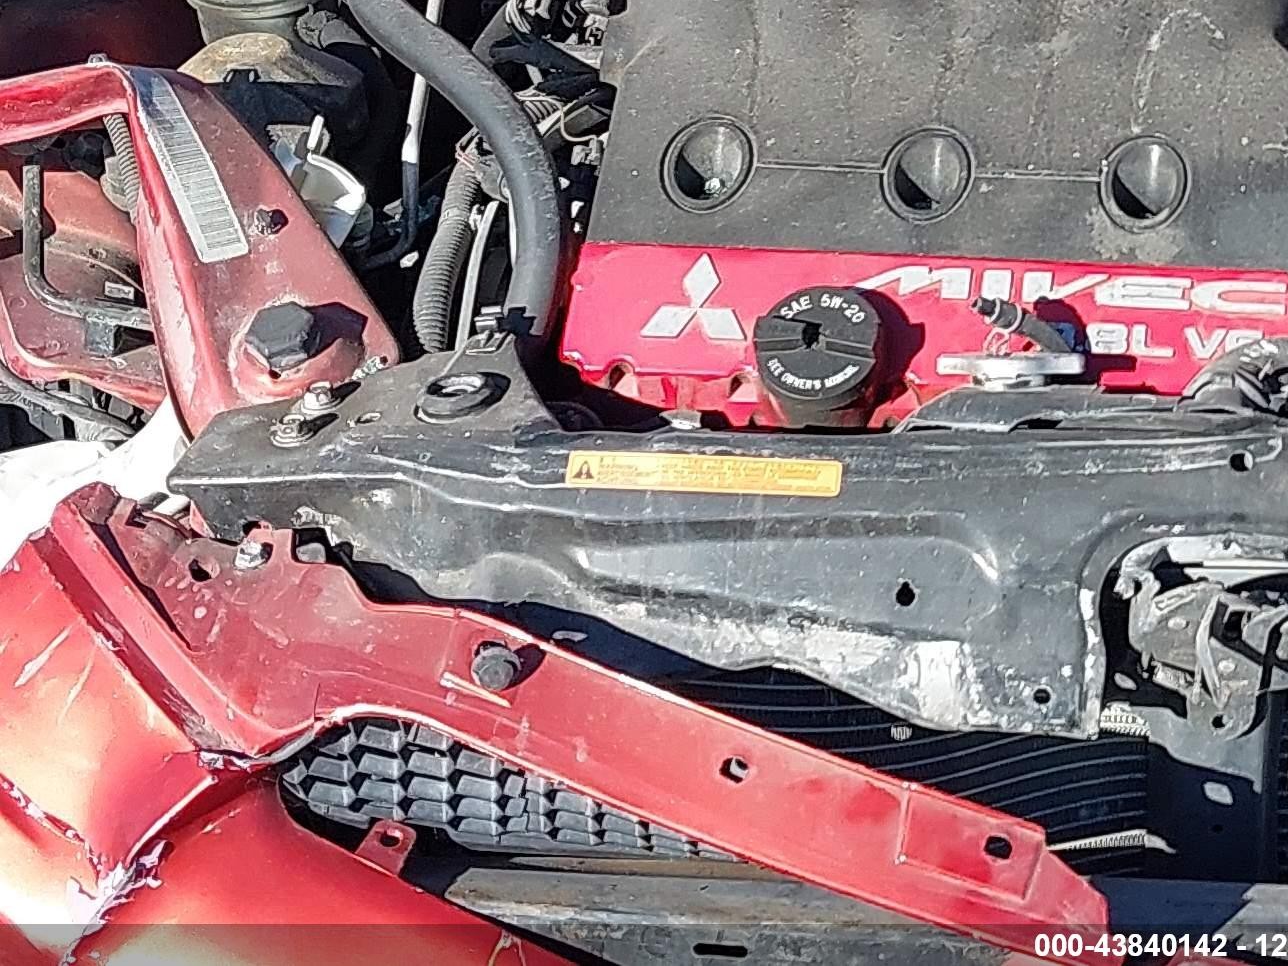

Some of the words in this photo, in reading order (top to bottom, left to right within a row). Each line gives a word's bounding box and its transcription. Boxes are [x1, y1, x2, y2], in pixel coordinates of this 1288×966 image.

[780, 294, 813, 319] SAE
[819, 293, 866, 323] 5W-20
[854, 265, 1288, 315] MIVEC
